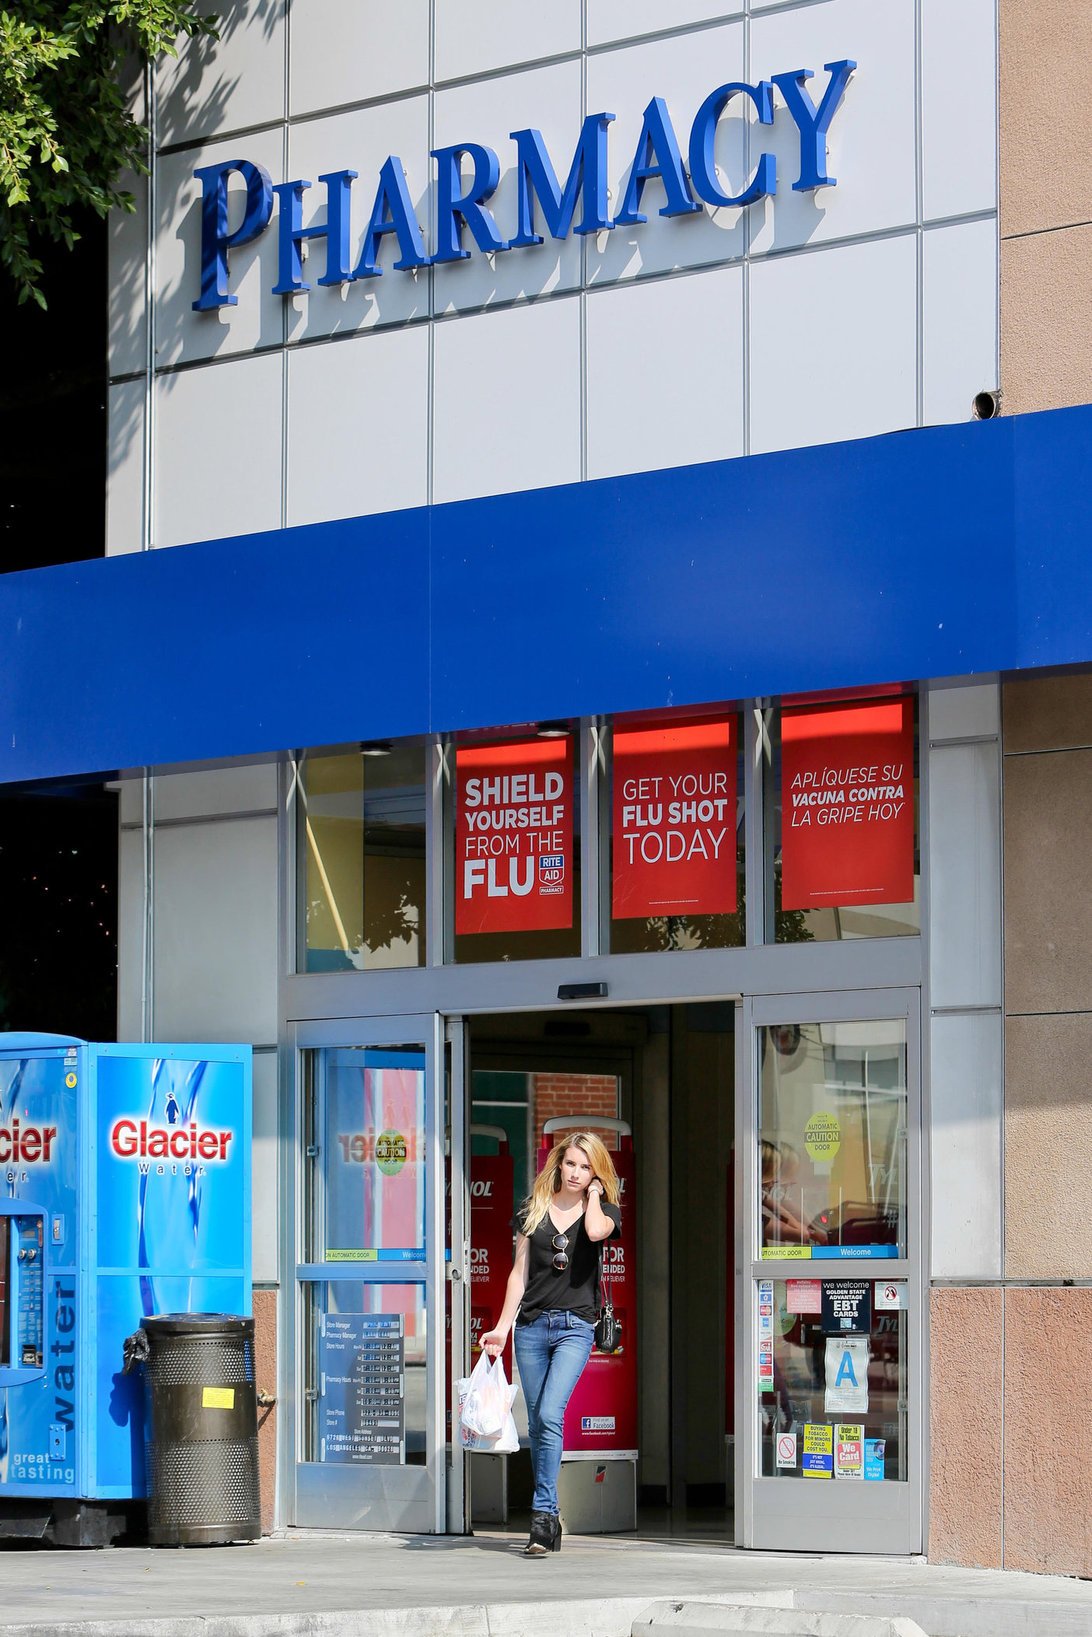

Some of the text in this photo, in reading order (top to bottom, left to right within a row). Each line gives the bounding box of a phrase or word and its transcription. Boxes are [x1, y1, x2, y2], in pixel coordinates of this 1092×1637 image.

[192, 59, 857, 312] PHARMACY
[465, 772, 564, 807] SHIELD
[623, 772, 727, 801] GET YOUR
[790, 764, 903, 790] APLÍQUESE SU
[791, 785, 904, 807] VACUNA CONTRA
[465, 805, 564, 832] YOURSELF
[622, 799, 728, 828] FLU SHOT
[791, 802, 904, 828] LA GRIPE HOY
[465, 830, 564, 858] FROM THE
[623, 827, 728, 865] TODAY
[542, 857, 561, 867] RITE
[464, 855, 535, 899] FLU
[544, 870, 560, 881] AID
[111, 1119, 232, 1160] Glacier
[806, 1132, 839, 1142] CAUTION
[840, 1248, 872, 1256] Welcome
[836, 1280, 870, 1289] welcome
[833, 1300, 859, 1311] EBT
[835, 1350, 859, 1387] A
[14, 1453, 50, 1466] great
[840, 1452, 860, 1461] Card
[842, 1443, 856, 1453] We
[11, 1464, 75, 1484] tasting
